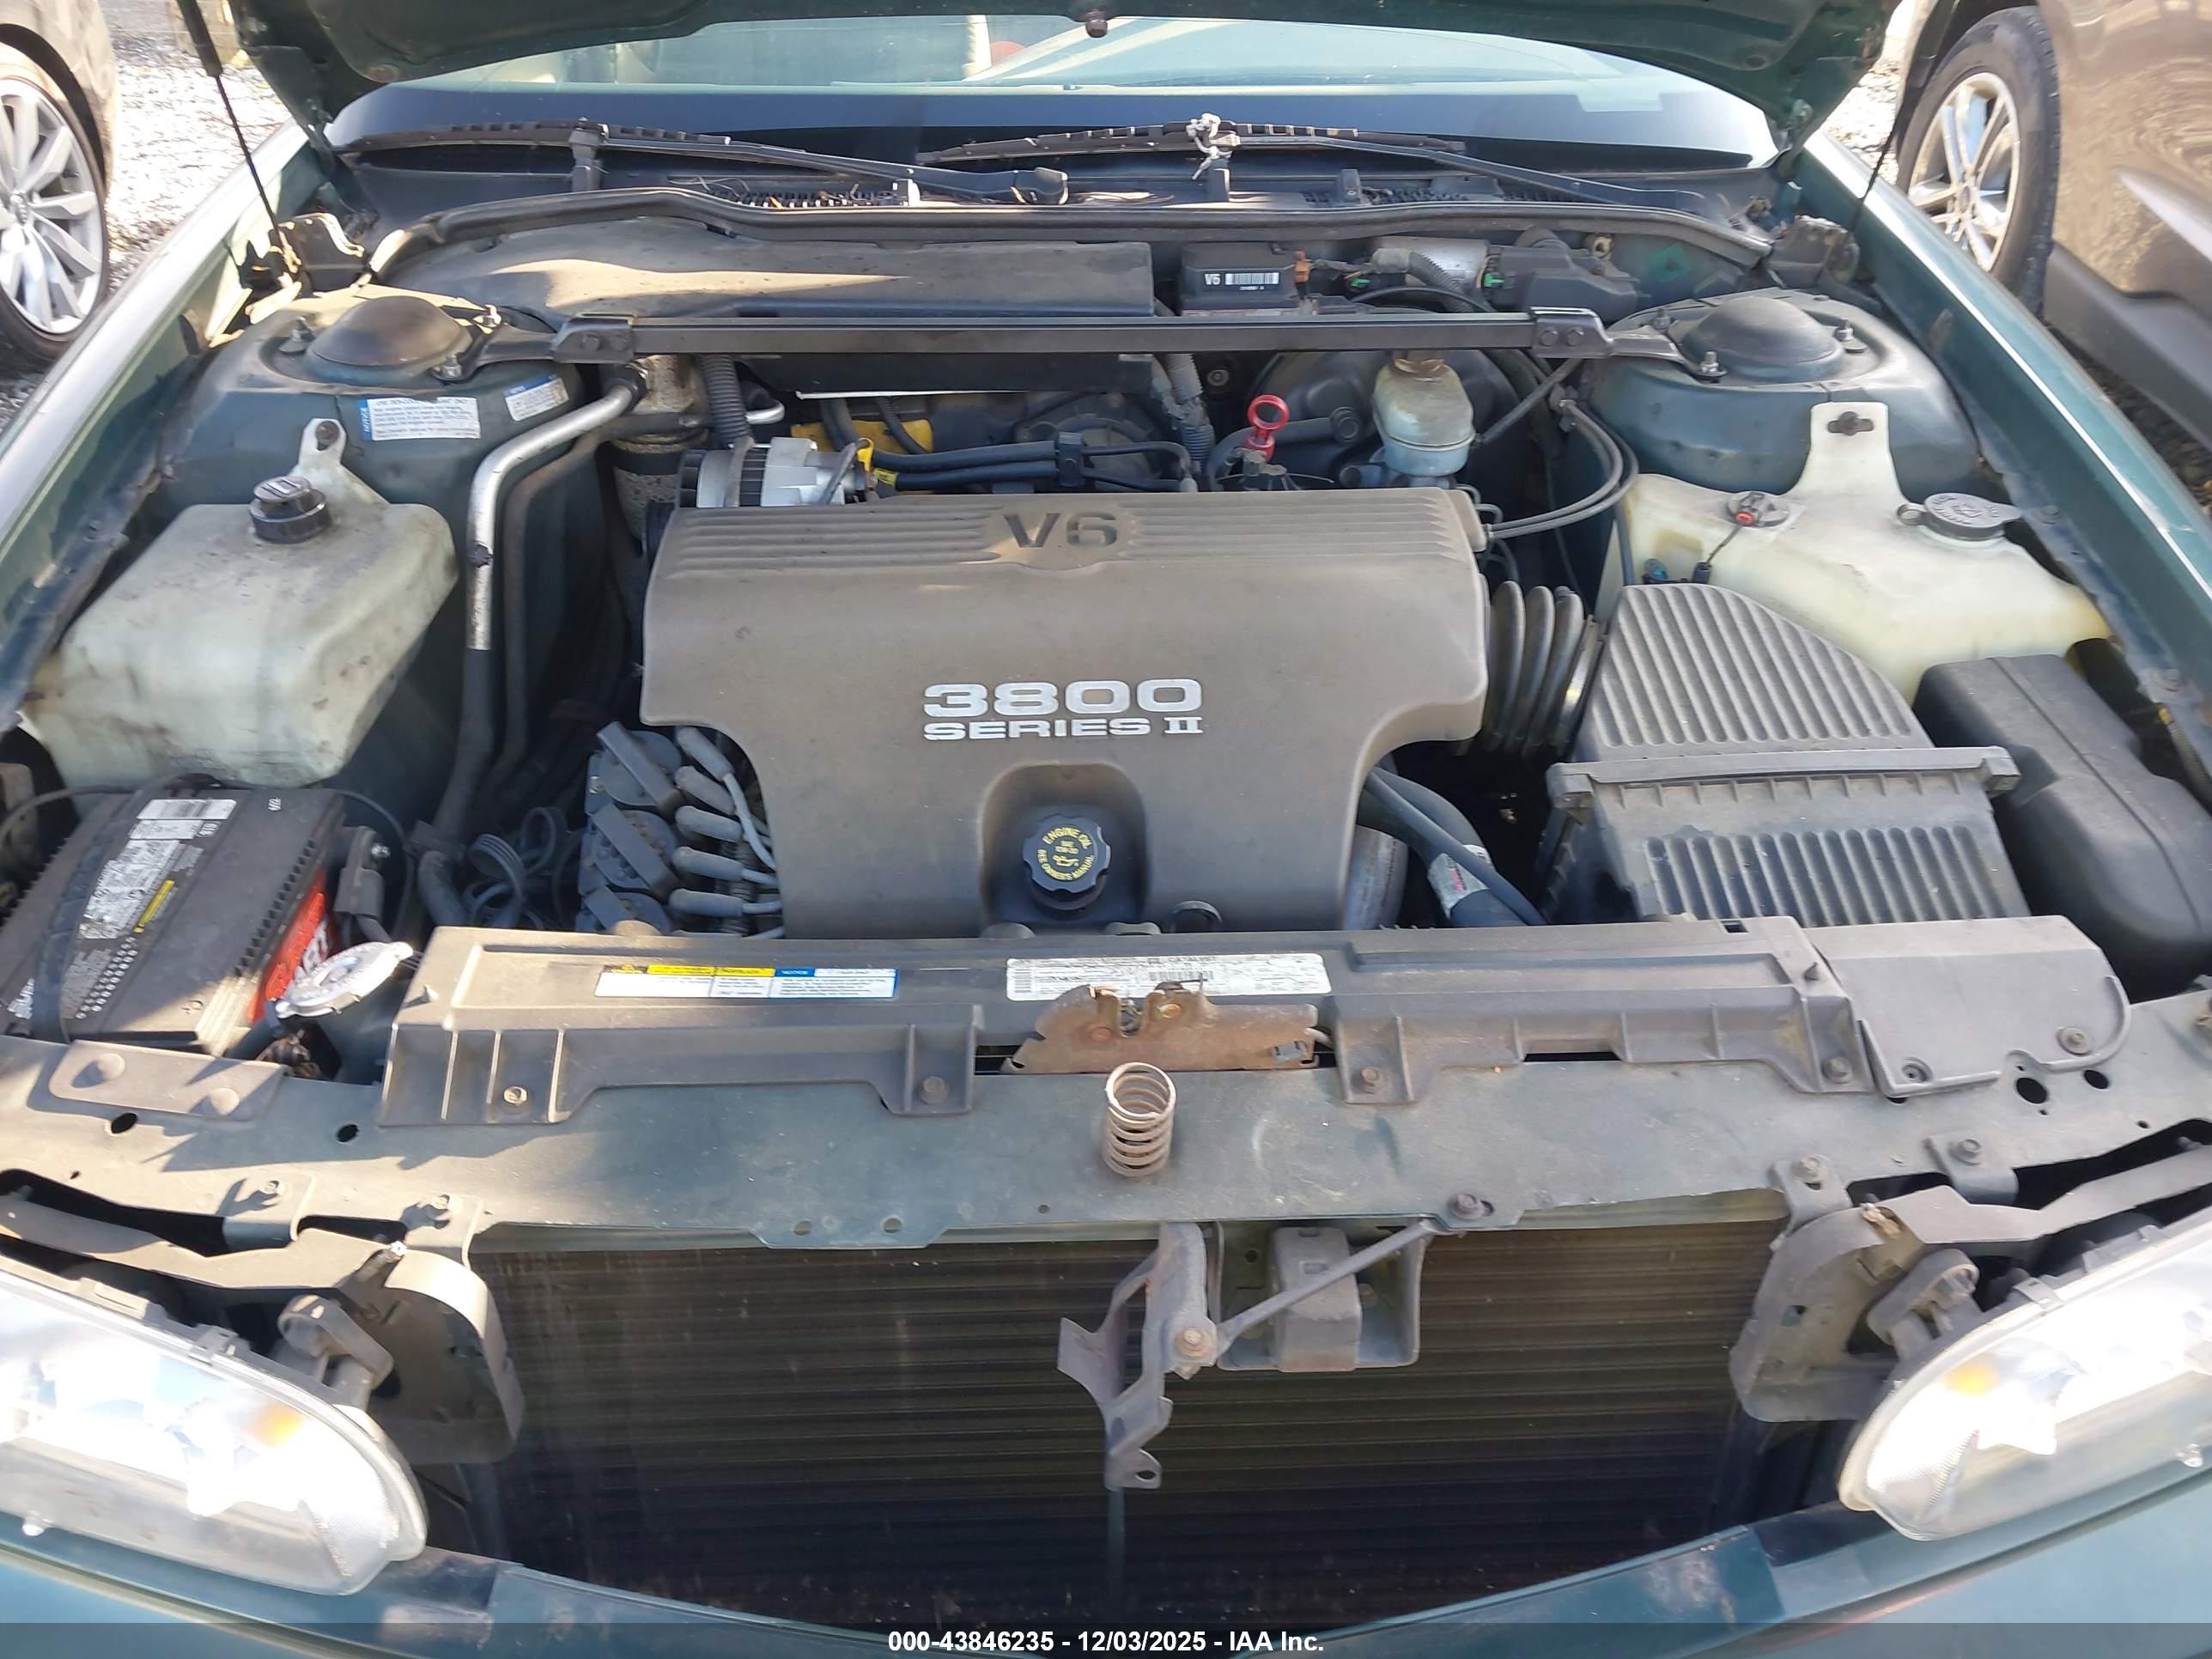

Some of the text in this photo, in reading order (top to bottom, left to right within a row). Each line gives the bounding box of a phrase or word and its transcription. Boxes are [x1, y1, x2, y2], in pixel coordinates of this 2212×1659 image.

[1204, 273, 1221, 286] V6
[1003, 512, 1118, 548] V6
[923, 678, 1202, 718] 3800
[923, 716, 1204, 741] SERIES II
[1042, 827, 1080, 844] ENGINE
[1079, 834, 1092, 849] OIL
[1036, 848, 1094, 880] SEE OWNER'S MANUAL
